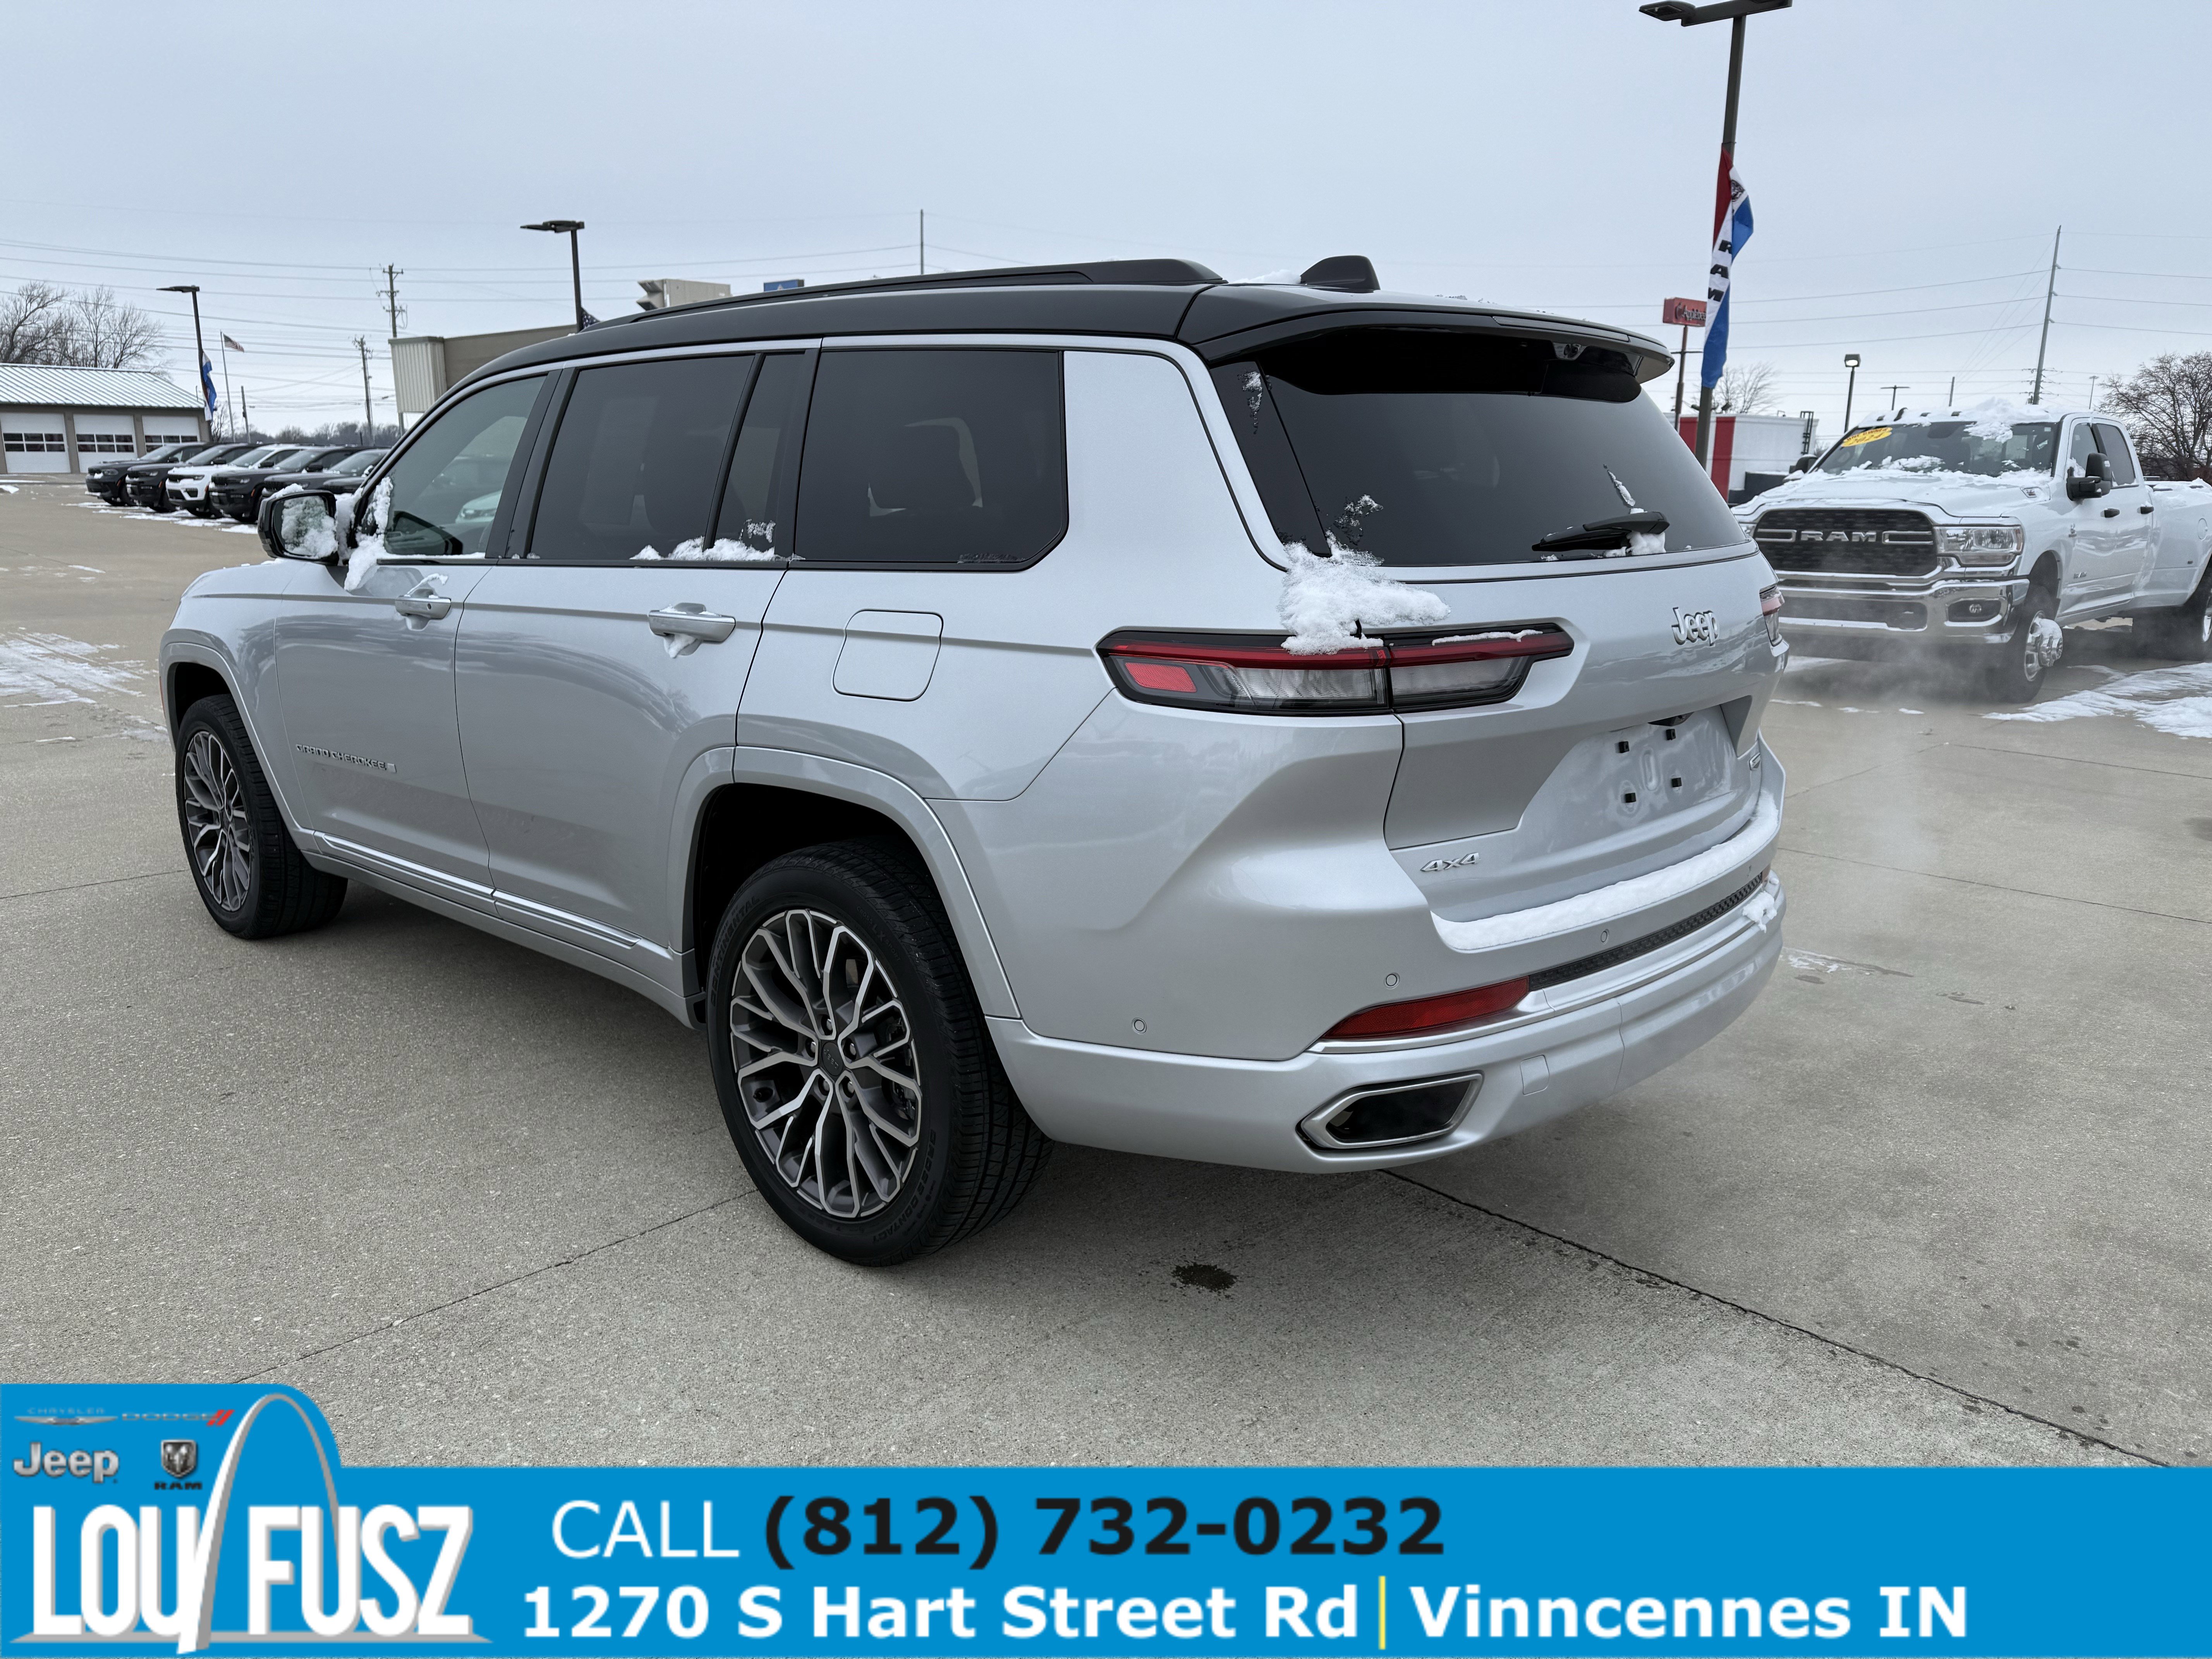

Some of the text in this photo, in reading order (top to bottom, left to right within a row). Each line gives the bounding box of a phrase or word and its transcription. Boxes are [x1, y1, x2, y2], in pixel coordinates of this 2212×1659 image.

[1800, 530, 1877, 542] RAM
[1671, 606, 1720, 647] Jeep
[295, 744, 387, 770] GRAND CHEROKEE
[1420, 852, 1480, 872] 4x4
